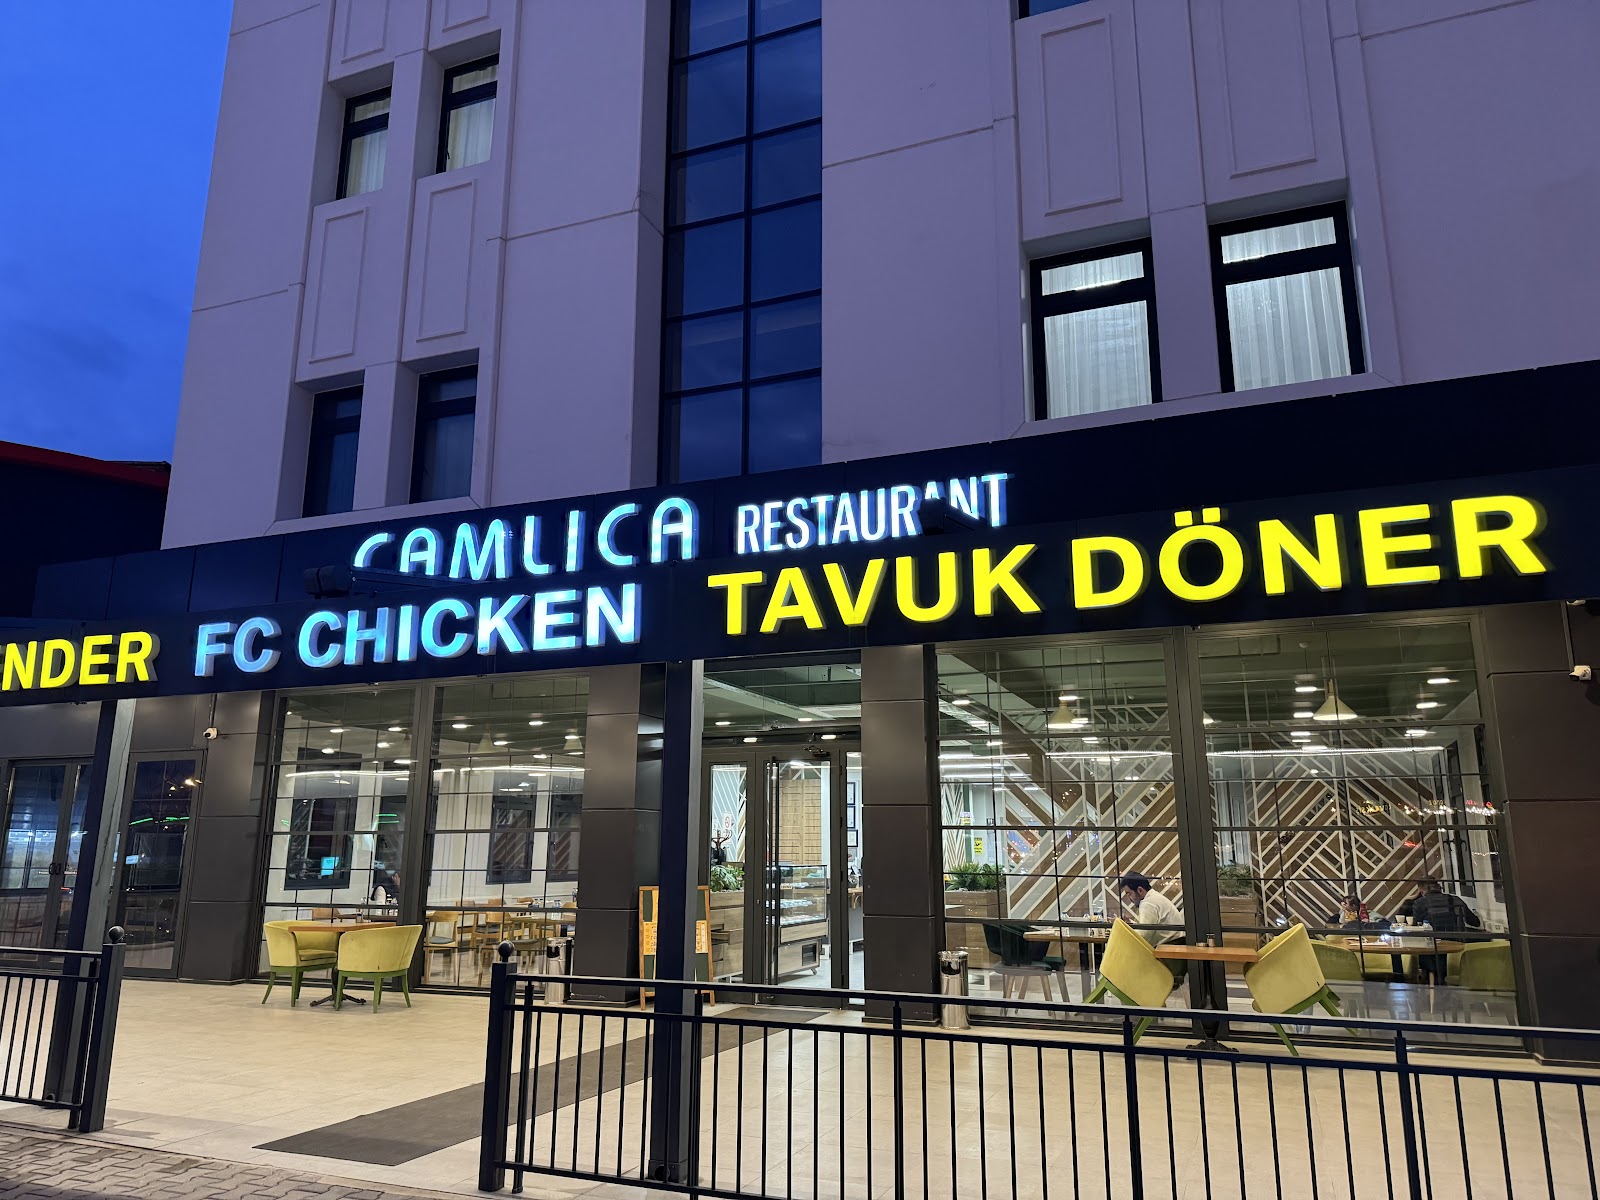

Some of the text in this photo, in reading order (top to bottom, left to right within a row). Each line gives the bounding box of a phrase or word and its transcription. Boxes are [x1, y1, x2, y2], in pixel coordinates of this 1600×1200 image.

[708, 495, 1546, 635] TAVUK DÖNER
[0, 631, 156, 692] NDER
[194, 582, 640, 678] FC CHICKEN
